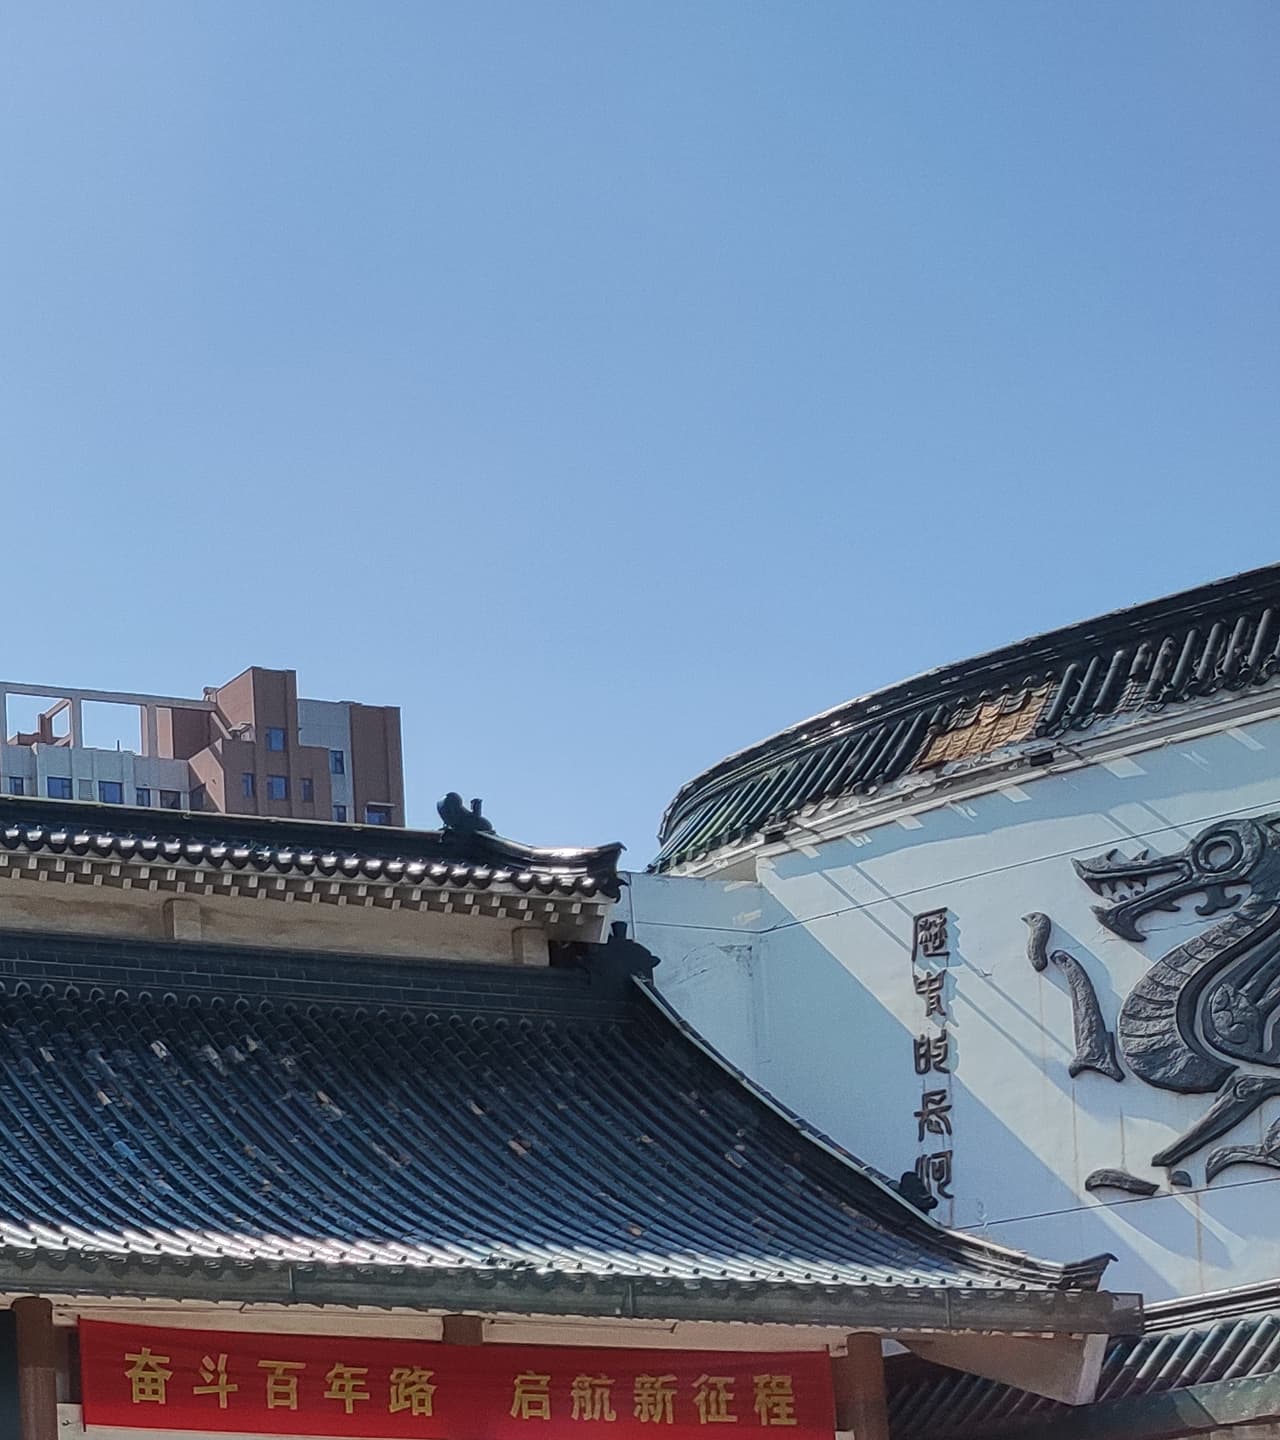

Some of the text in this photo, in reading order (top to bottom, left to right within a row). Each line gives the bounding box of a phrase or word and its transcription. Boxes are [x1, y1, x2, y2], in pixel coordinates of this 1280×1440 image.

[124, 1347, 798, 1426] 奋斗百年路 启航新征程
